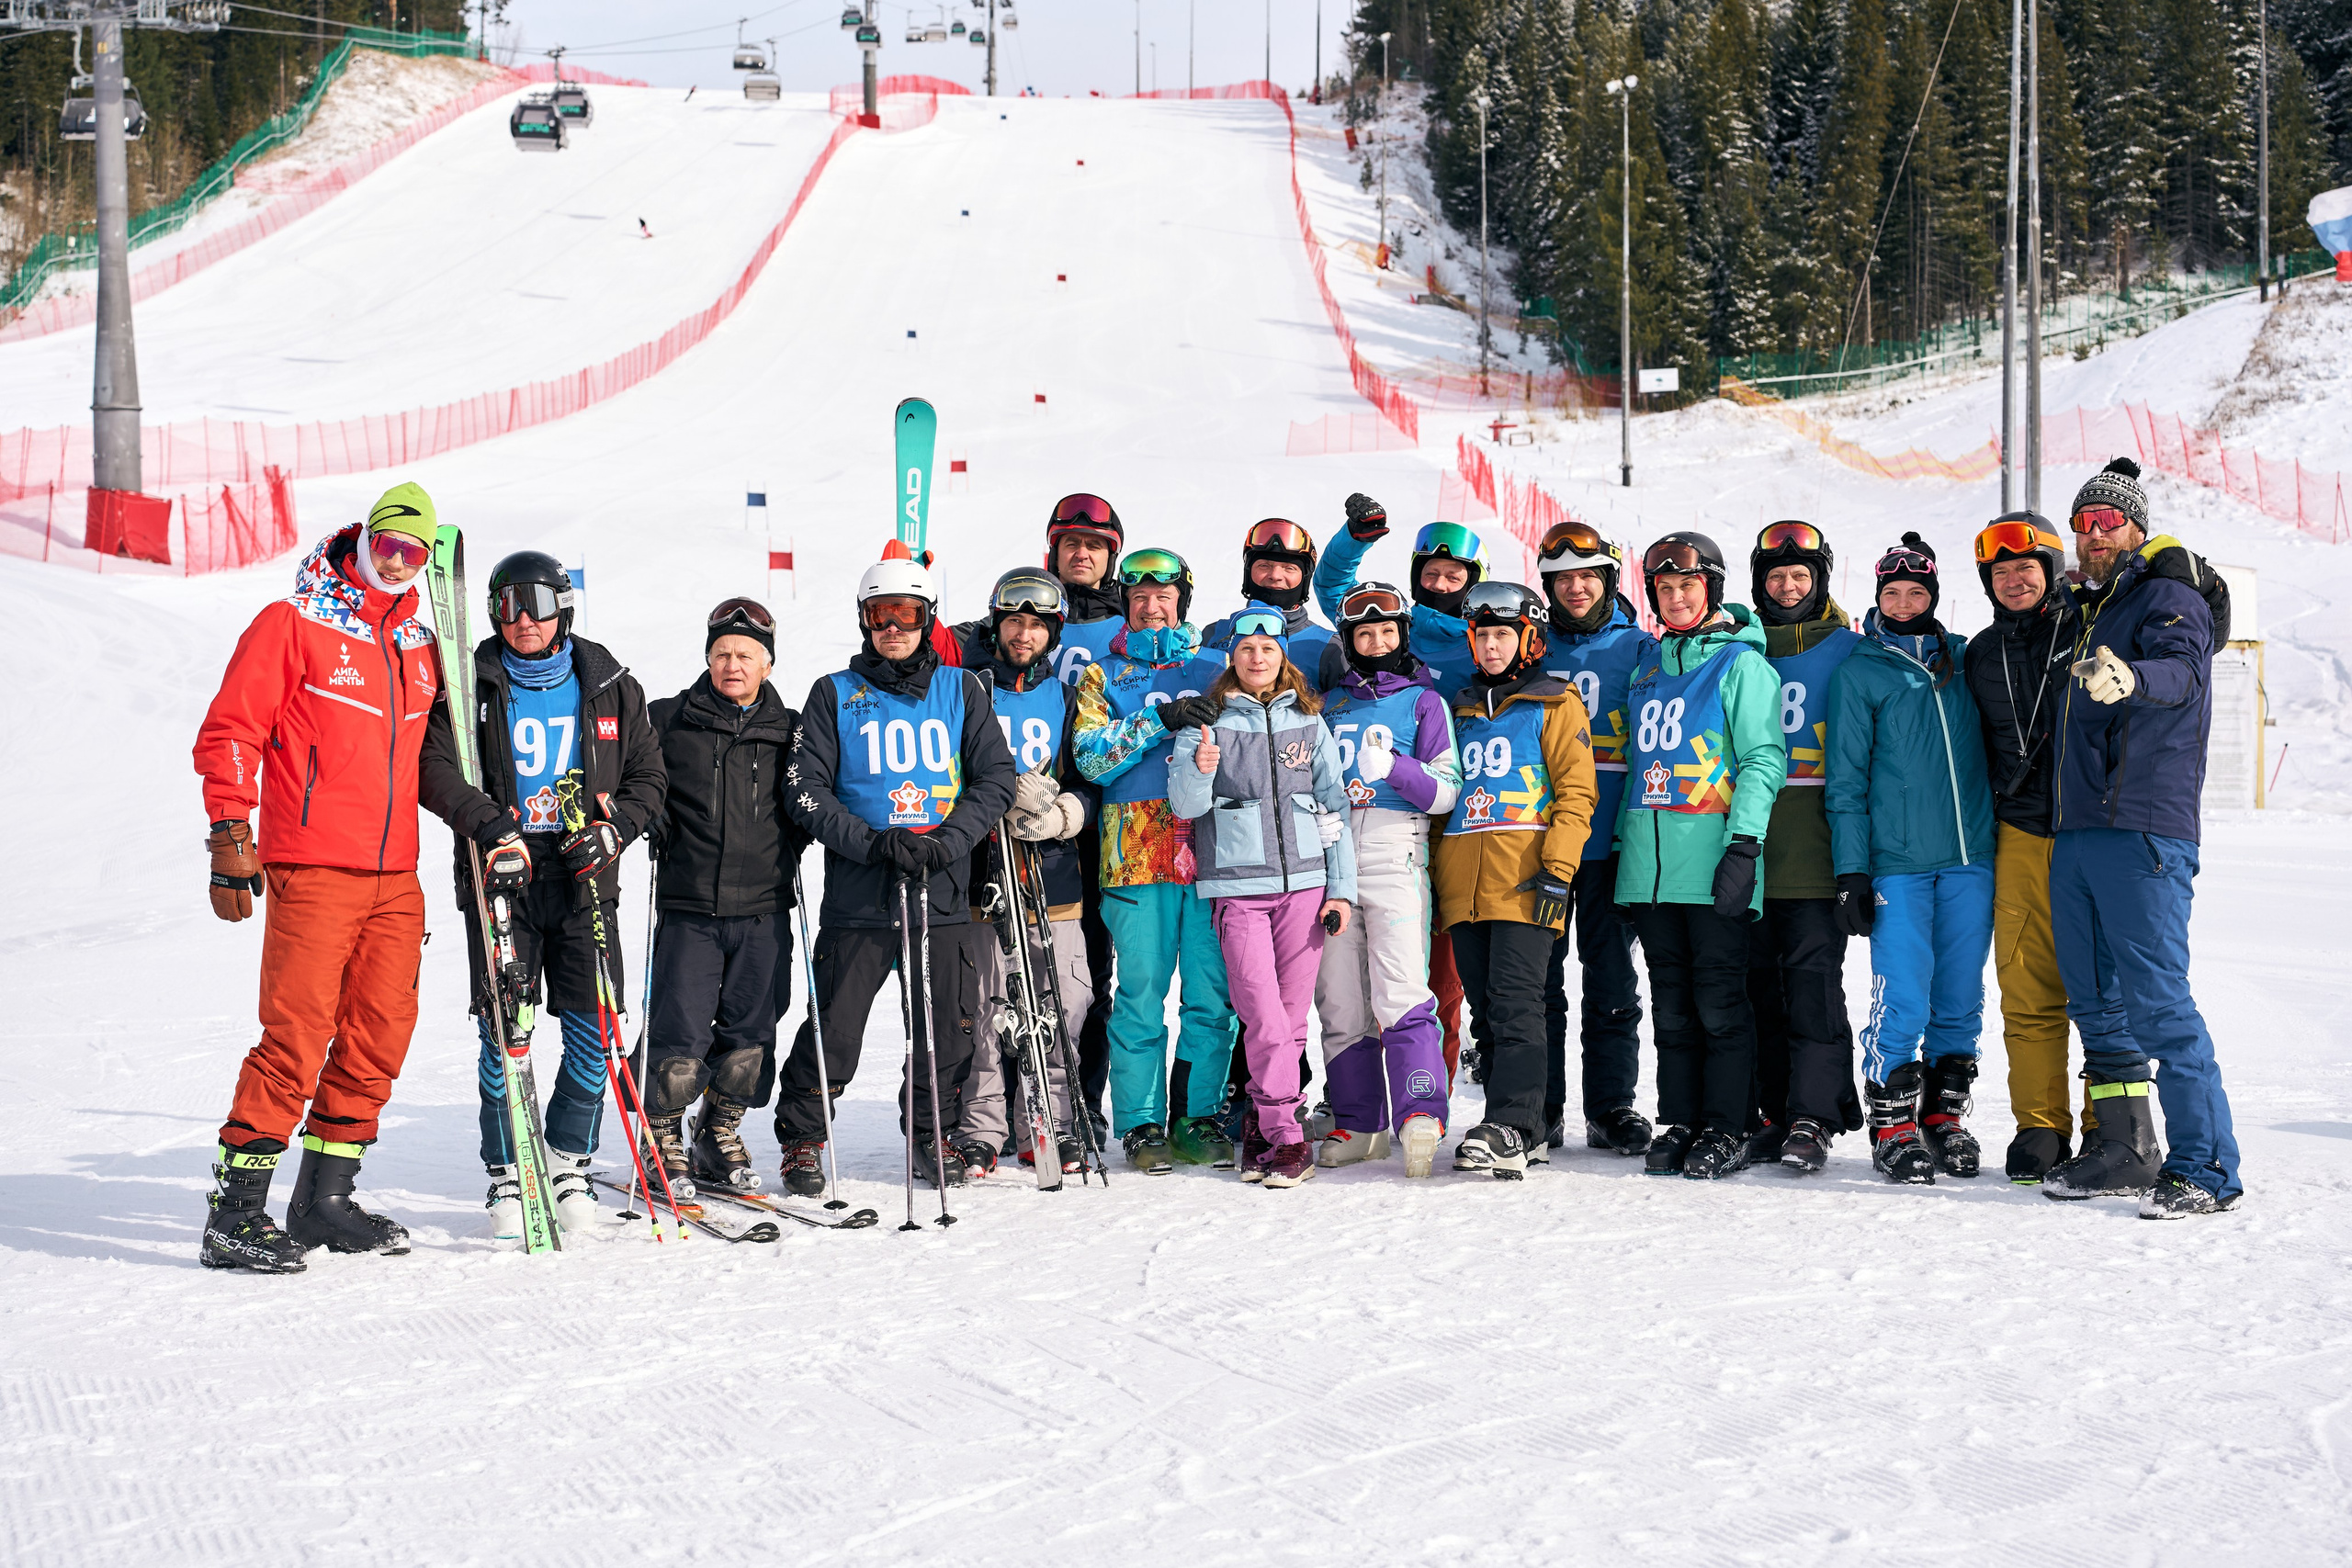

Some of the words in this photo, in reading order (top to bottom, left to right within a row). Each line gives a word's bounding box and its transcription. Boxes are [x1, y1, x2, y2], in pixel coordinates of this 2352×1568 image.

[329, 676, 365, 686] МЕЧТЫ
[334, 668, 359, 676] ЛИГА
[1120, 682, 1140, 692] ЮГРА
[842, 700, 880, 710] ФГСиРК
[852, 708, 872, 716] ЮГРА
[598, 721, 616, 735] HH
[1637, 697, 1685, 752] 88
[514, 716, 575, 776] 97
[860, 718, 951, 774] 100
[1284, 739, 1313, 769] Ski
[1463, 737, 1511, 780] 99
[561, 834, 579, 851] LEKI
[498, 862, 523, 870] LEKI
[521, 1141, 532, 1163] 191
[243, 1156, 278, 1168] RC4
[524, 1163, 537, 1200] GSX
[529, 1199, 544, 1247] RACE
[205, 1227, 278, 1264] FISCHER
